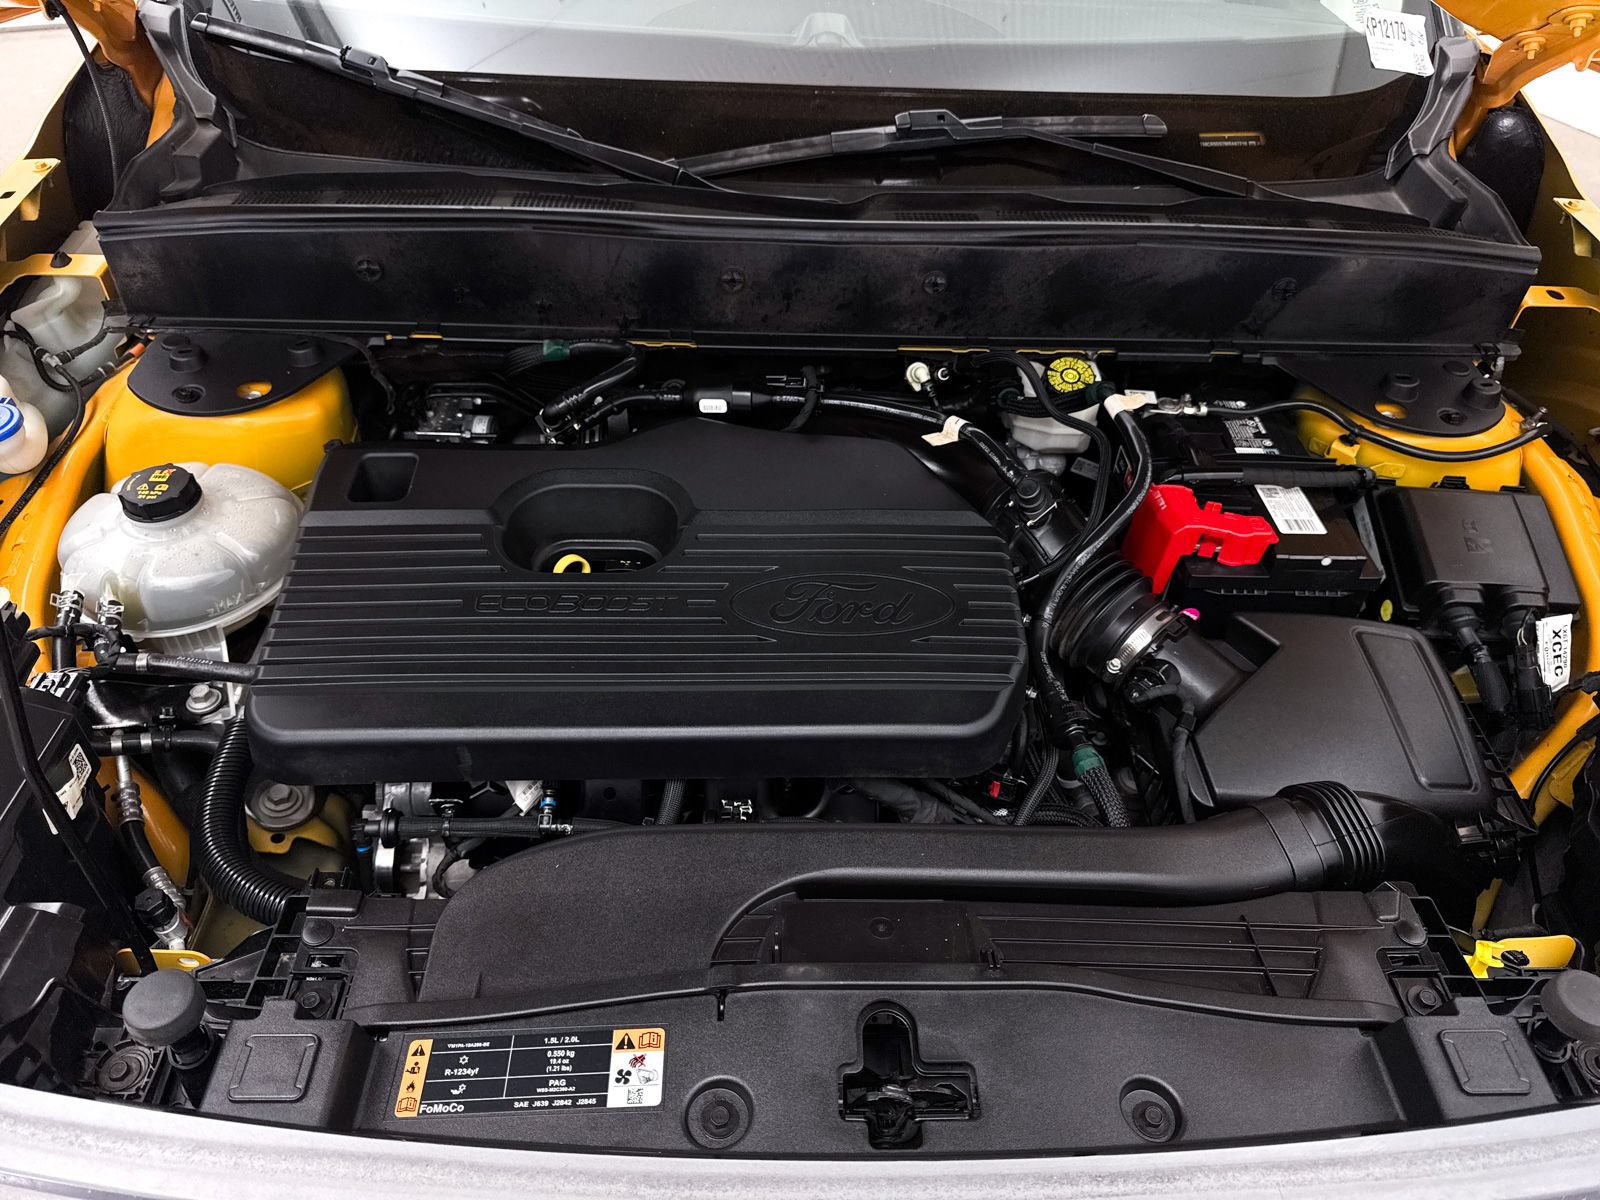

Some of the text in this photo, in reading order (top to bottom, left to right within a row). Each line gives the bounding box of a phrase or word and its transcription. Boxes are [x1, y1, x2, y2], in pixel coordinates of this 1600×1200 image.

[768, 580, 915, 625] Ford
[546, 1050, 575, 1058] 0.550 kg
[444, 1067, 480, 1077] R-1234yf
[548, 1079, 567, 1087] PAG
[419, 1102, 465, 1114] FoMoCo
